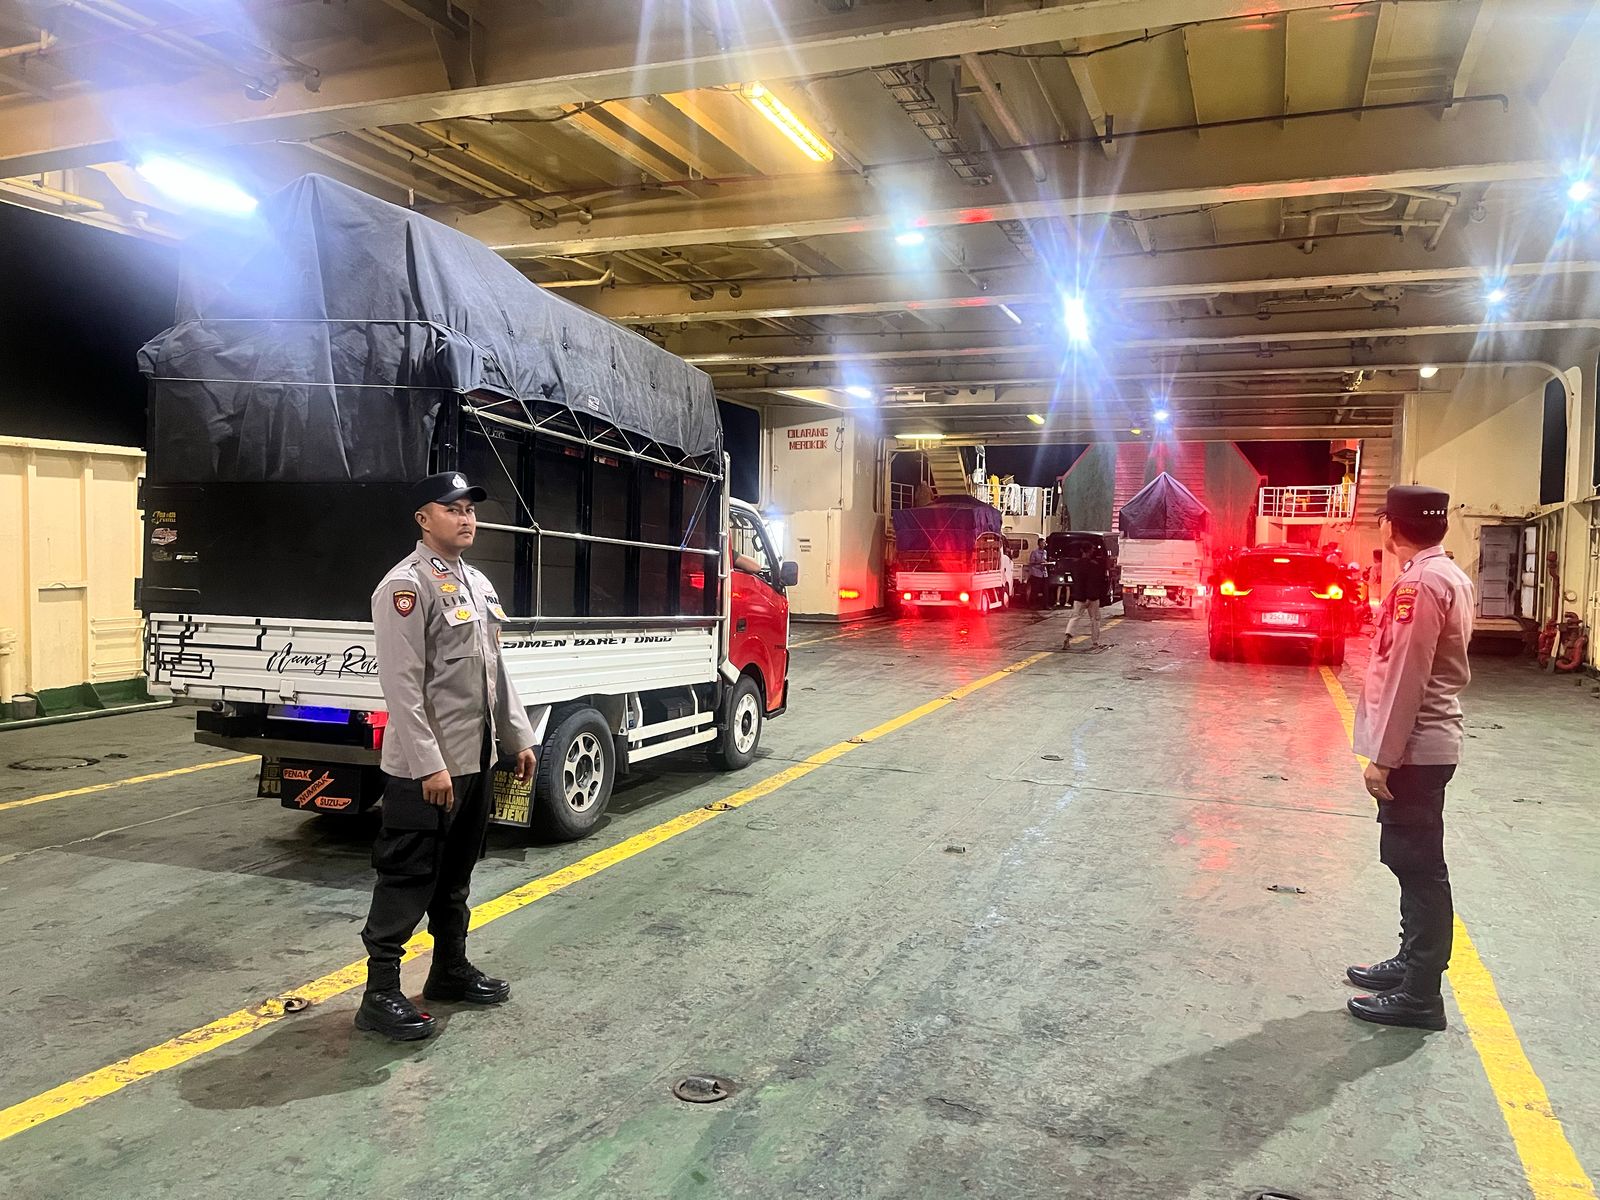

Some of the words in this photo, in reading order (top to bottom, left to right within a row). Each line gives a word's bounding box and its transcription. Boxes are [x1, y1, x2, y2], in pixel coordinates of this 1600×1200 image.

[787, 428, 829, 438] DILARANG
[789, 440, 827, 450] MEROKOK
[284, 769, 309, 779] PENAK
[300, 775, 328, 804] NUMPAK
[490, 809, 528, 822] EJEKI
